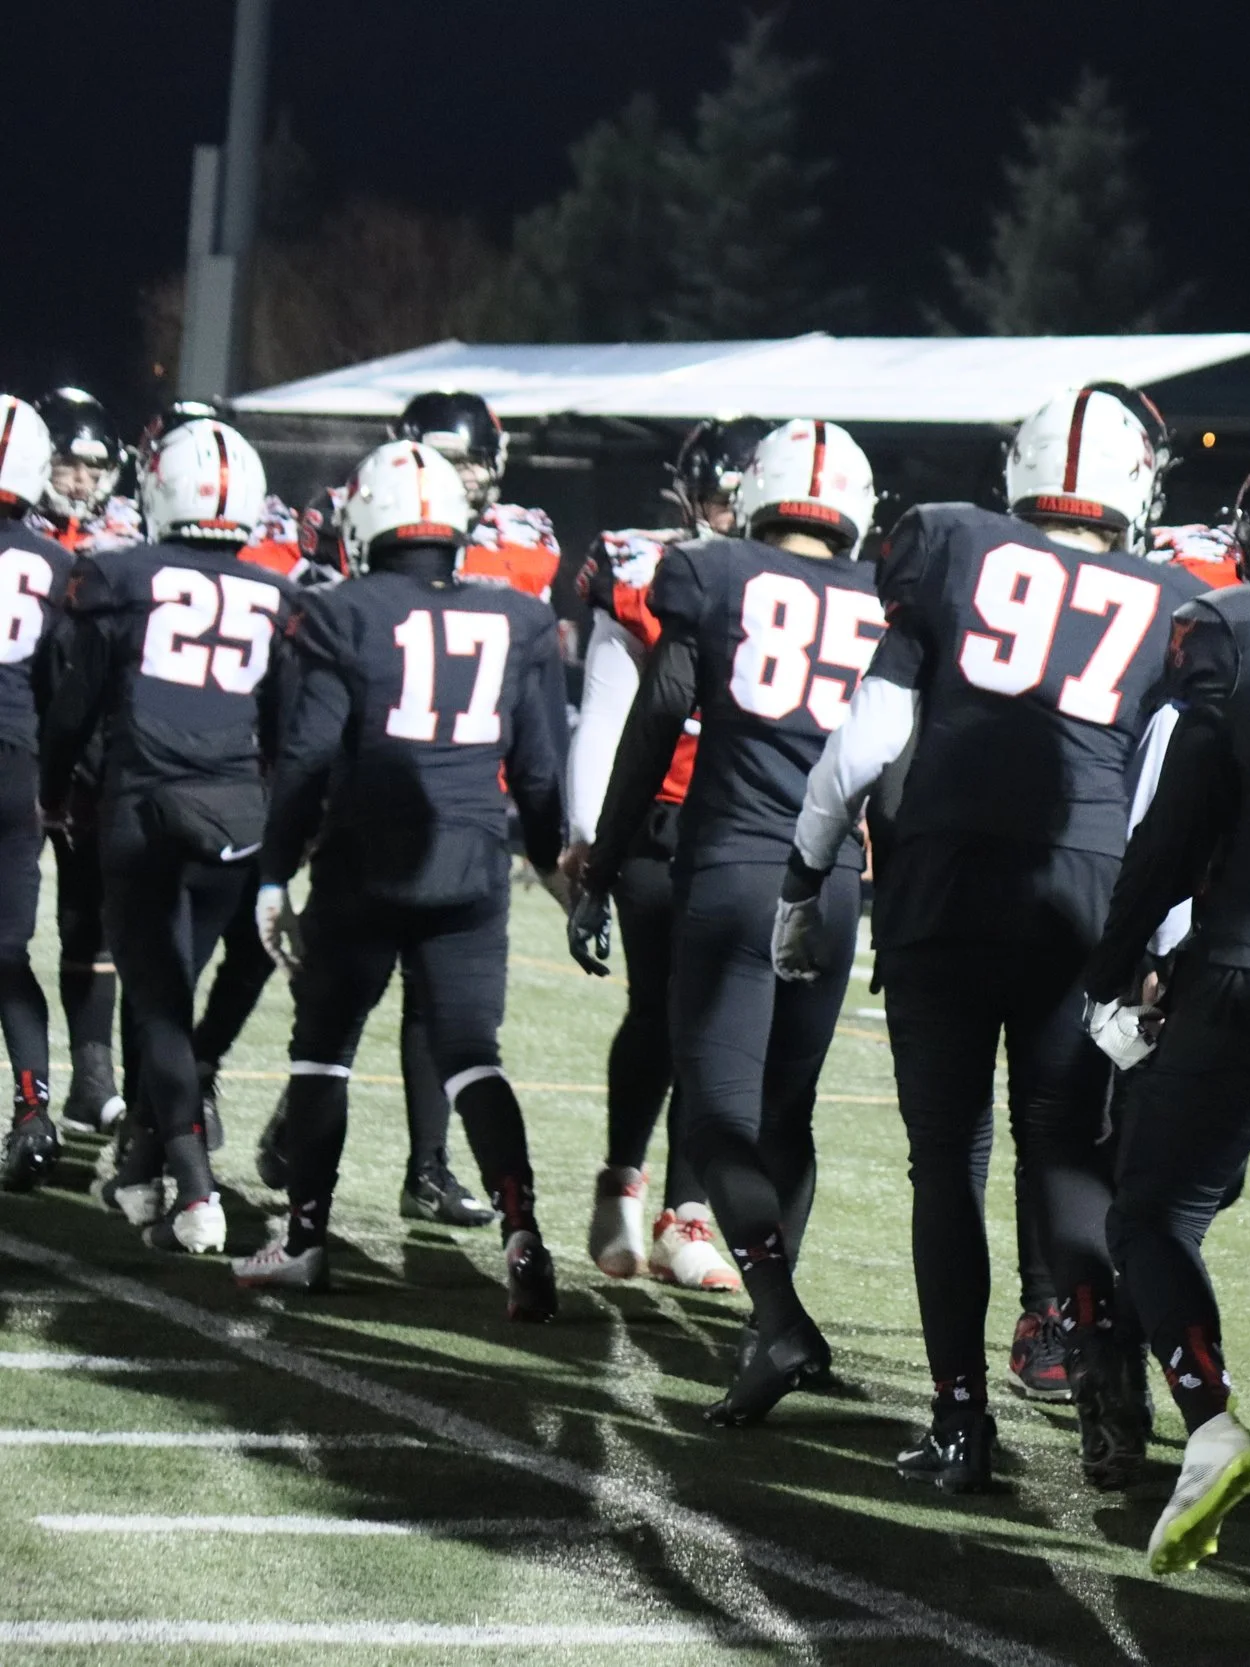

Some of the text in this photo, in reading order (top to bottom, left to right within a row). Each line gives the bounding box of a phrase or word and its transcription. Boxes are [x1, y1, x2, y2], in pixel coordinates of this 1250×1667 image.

[141, 565, 281, 695] 25
[385, 609, 510, 744] 17
[730, 570, 889, 731] 85
[959, 541, 1161, 726] 97
